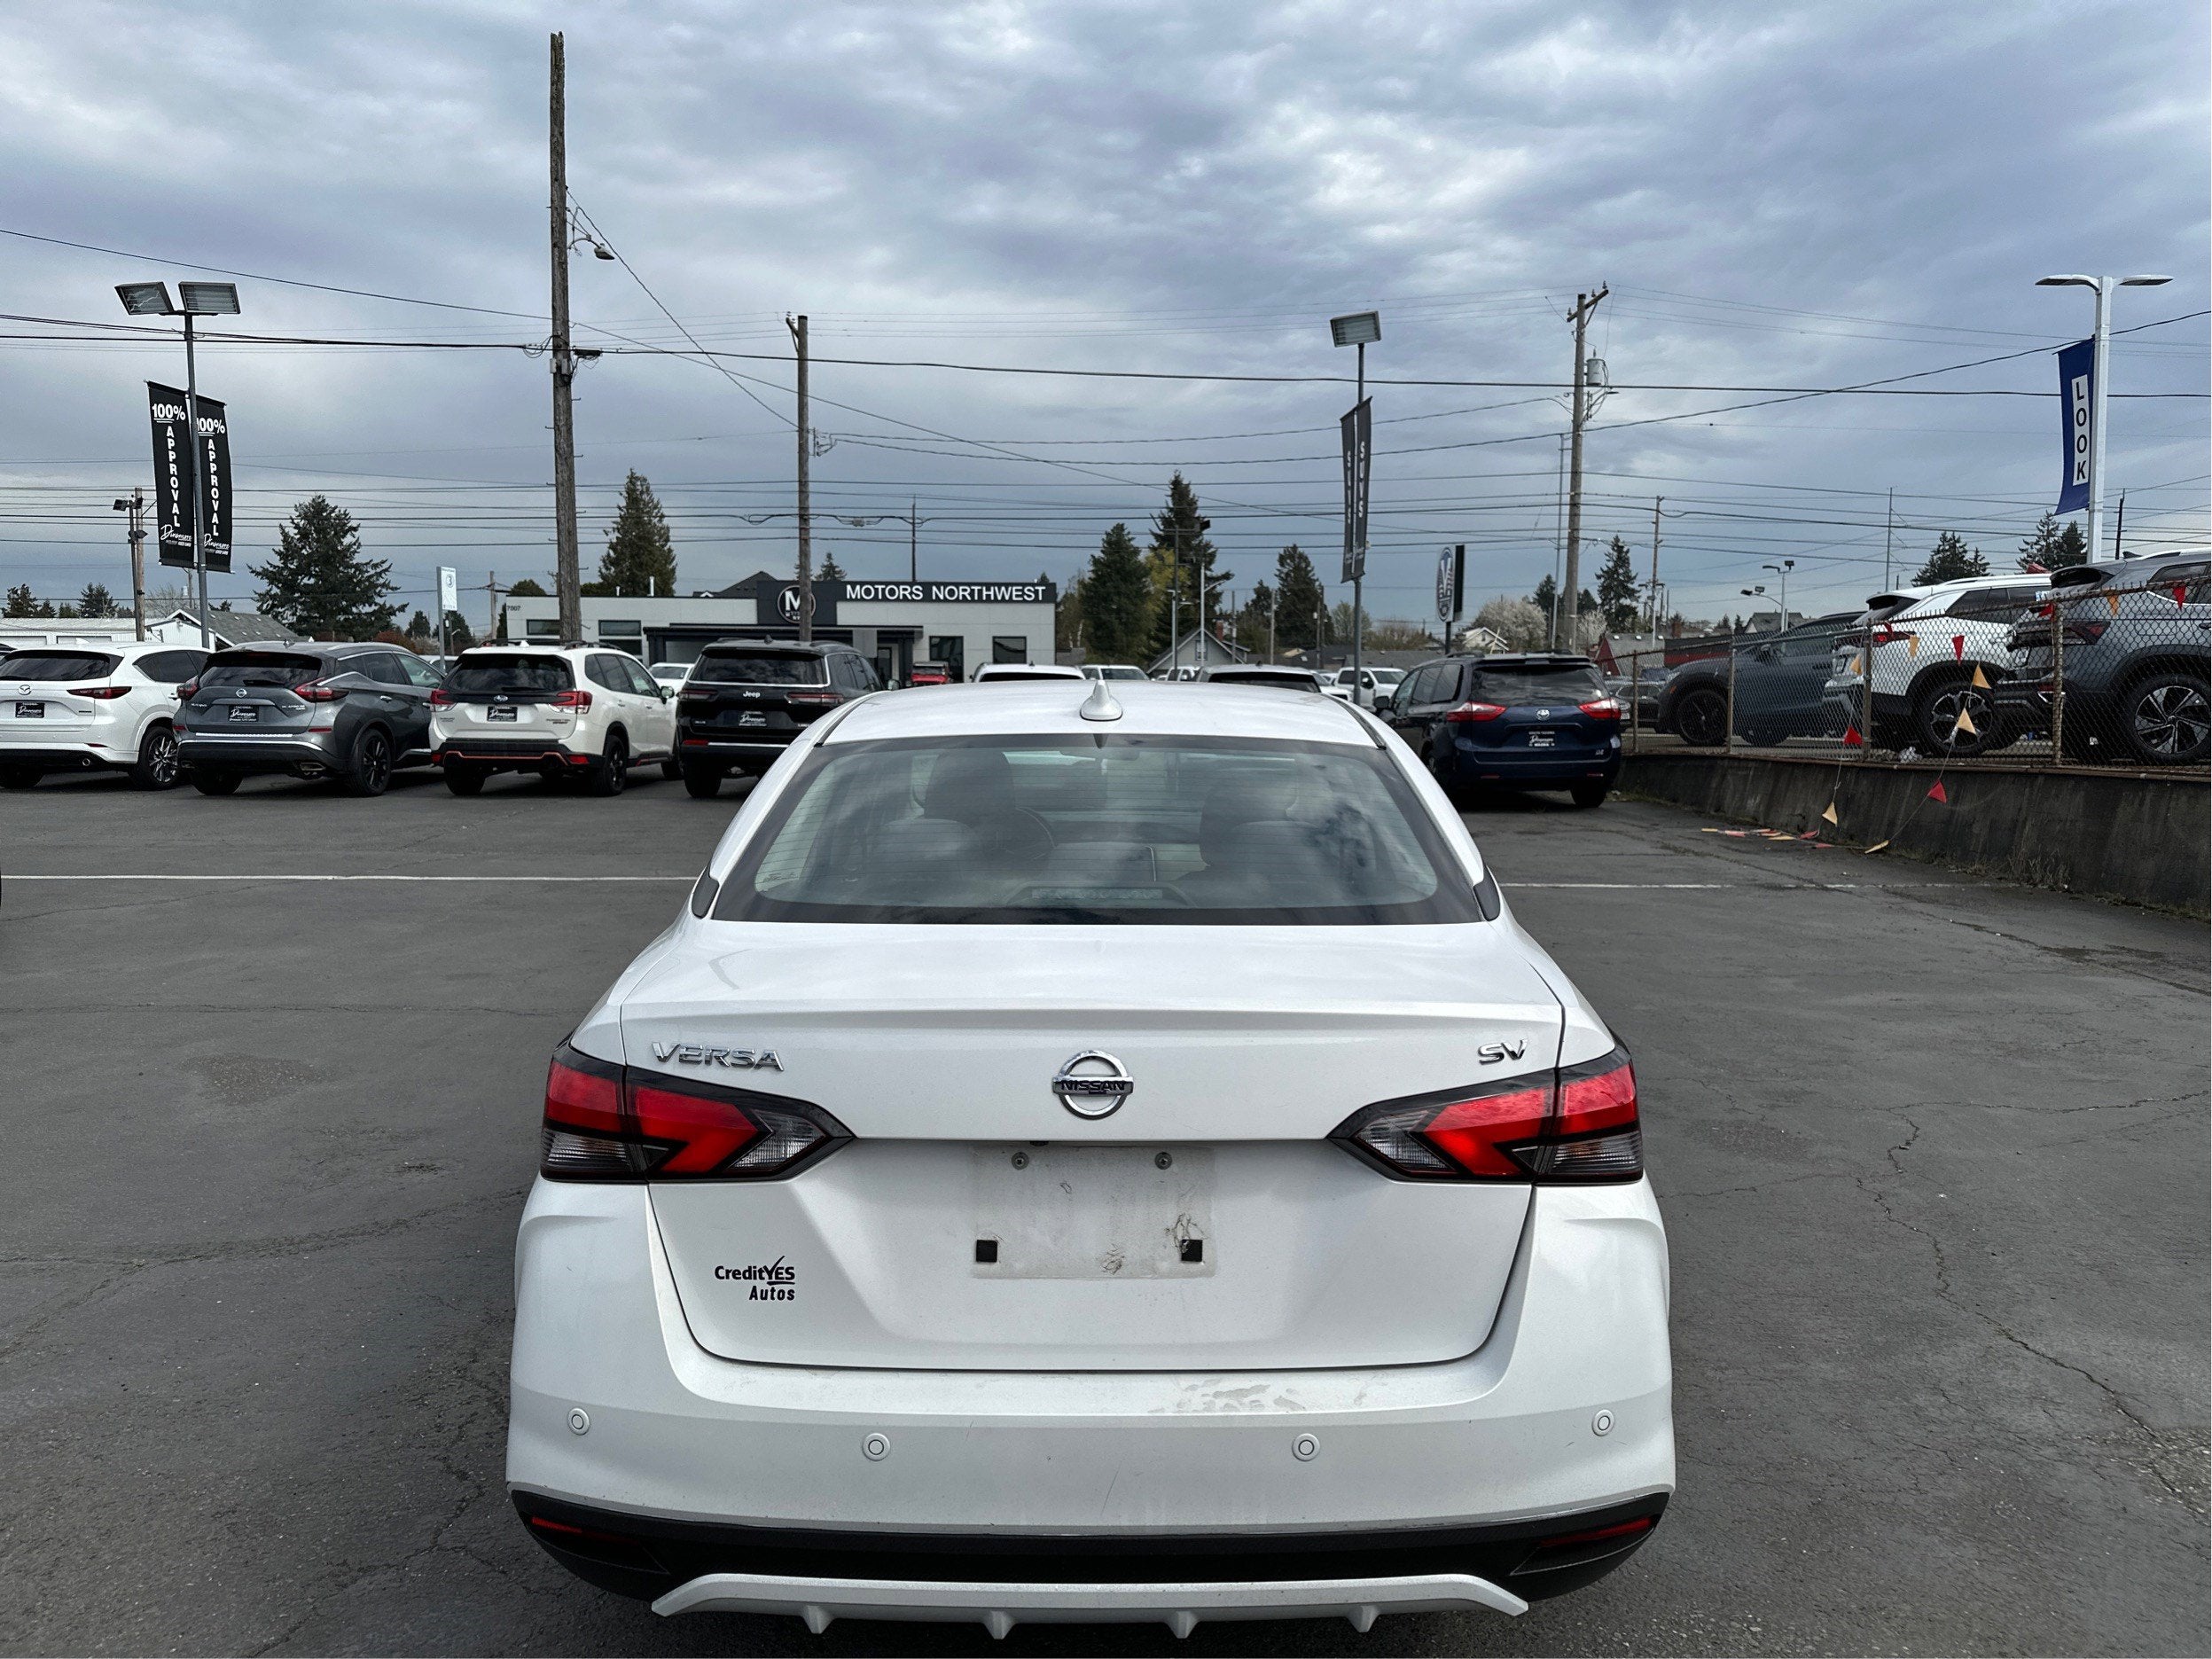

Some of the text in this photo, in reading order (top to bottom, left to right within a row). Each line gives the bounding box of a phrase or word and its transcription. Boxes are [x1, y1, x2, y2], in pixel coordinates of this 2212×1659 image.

[152, 403, 186, 421] 100%
[2075, 381, 2088, 481] LOOK
[166, 426, 181, 528] APPROVAL
[207, 439, 220, 536] APPROVAL
[846, 584, 1046, 601] MOTORS NORTHWEST
[652, 1041, 785, 1071] VERSA
[1477, 1038, 1528, 1065] SV
[1060, 1080, 1125, 1092] NISSAN
[749, 1285, 795, 1301] Autos
